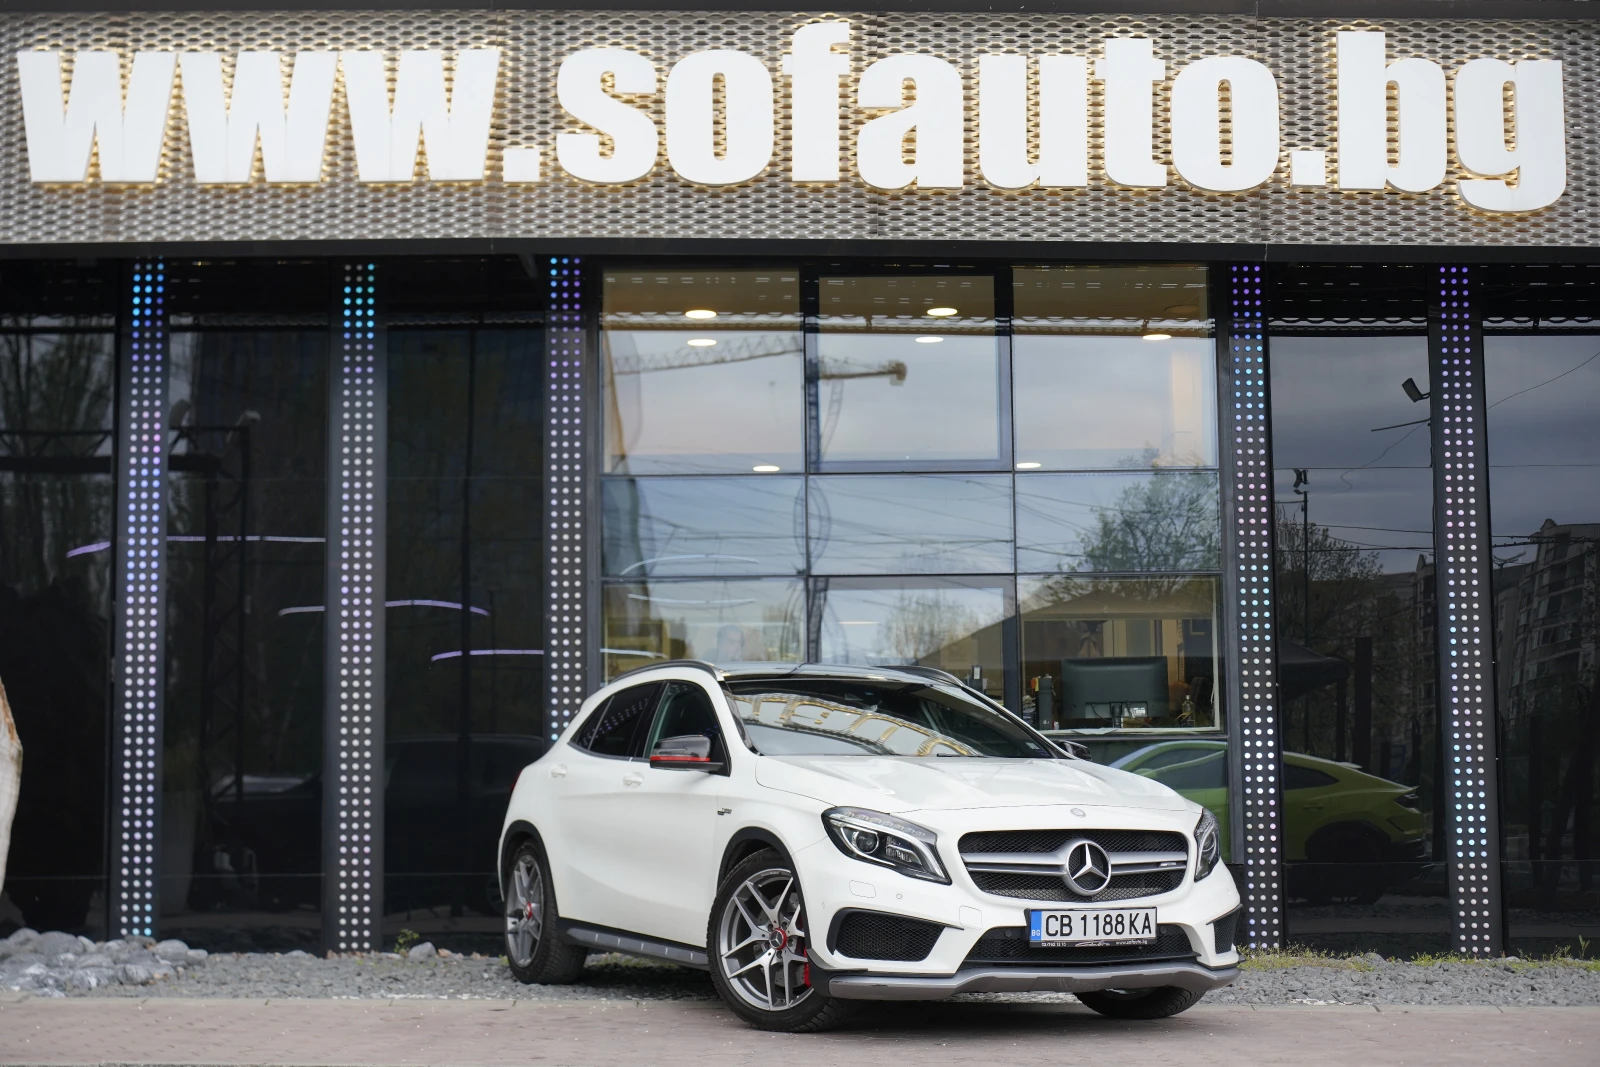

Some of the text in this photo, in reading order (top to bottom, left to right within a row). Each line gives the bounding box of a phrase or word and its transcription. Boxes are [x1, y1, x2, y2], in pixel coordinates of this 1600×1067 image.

[16, 22, 1567, 212] www.sofauto.bg
[1031, 929, 1041, 937] BG
[1045, 912, 1152, 937] CB 1188 KA
